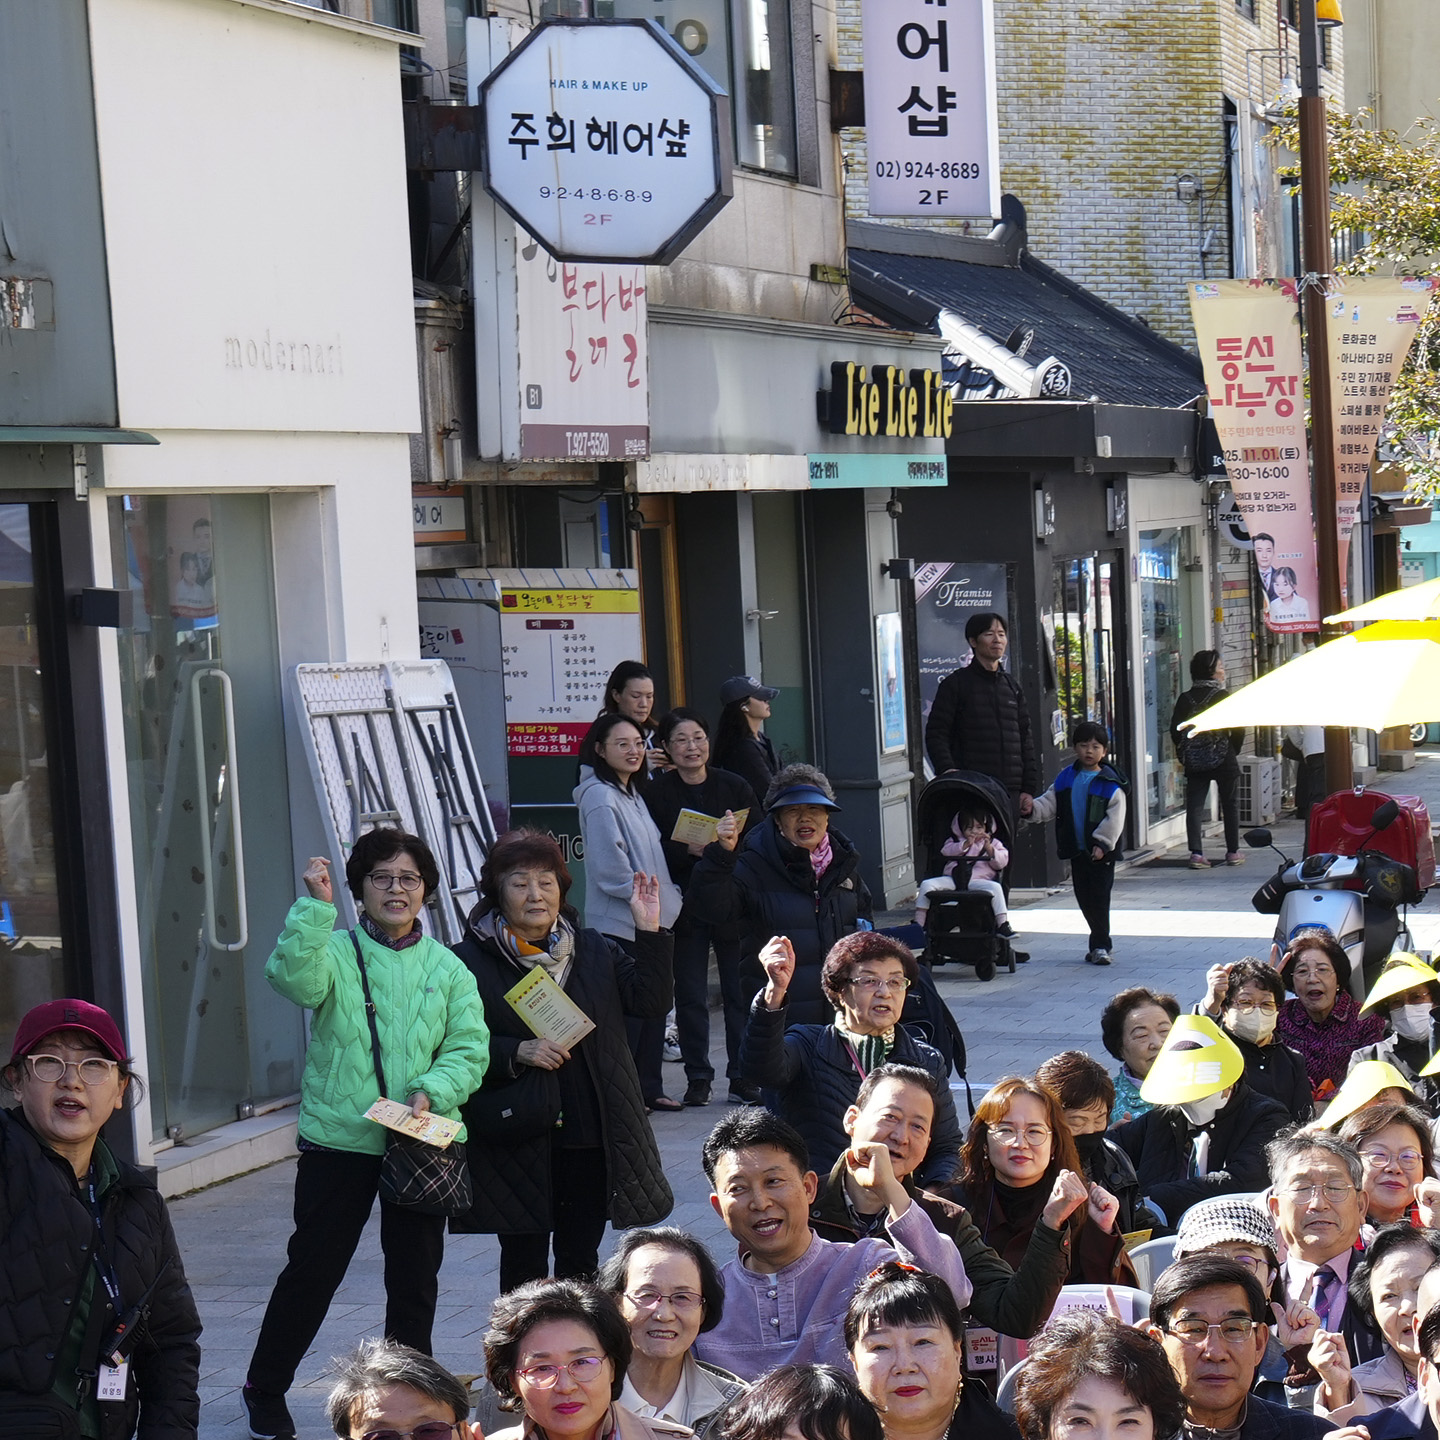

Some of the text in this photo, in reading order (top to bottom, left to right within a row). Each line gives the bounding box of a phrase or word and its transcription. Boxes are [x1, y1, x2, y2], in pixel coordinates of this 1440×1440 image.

[897, 0, 957, 137] 어샵
[550, 79, 649, 92] HAIR & MAKE UP
[918, 189, 949, 205] 2F
[583, 213, 613, 226] 2F
[1342, 333, 1377, 345] 문화공연
[1216, 335, 1275, 382] 동선
[1340, 353, 1375, 364] 아나바다
[1340, 372, 1356, 383] 주민
[529, 387, 540, 406] B1
[845, 361, 953, 439] Lie Lie Lie
[565, 431, 610, 456] T.927-5520
[917, 564, 939, 587] NEW
[954, 598, 992, 608] icecream
